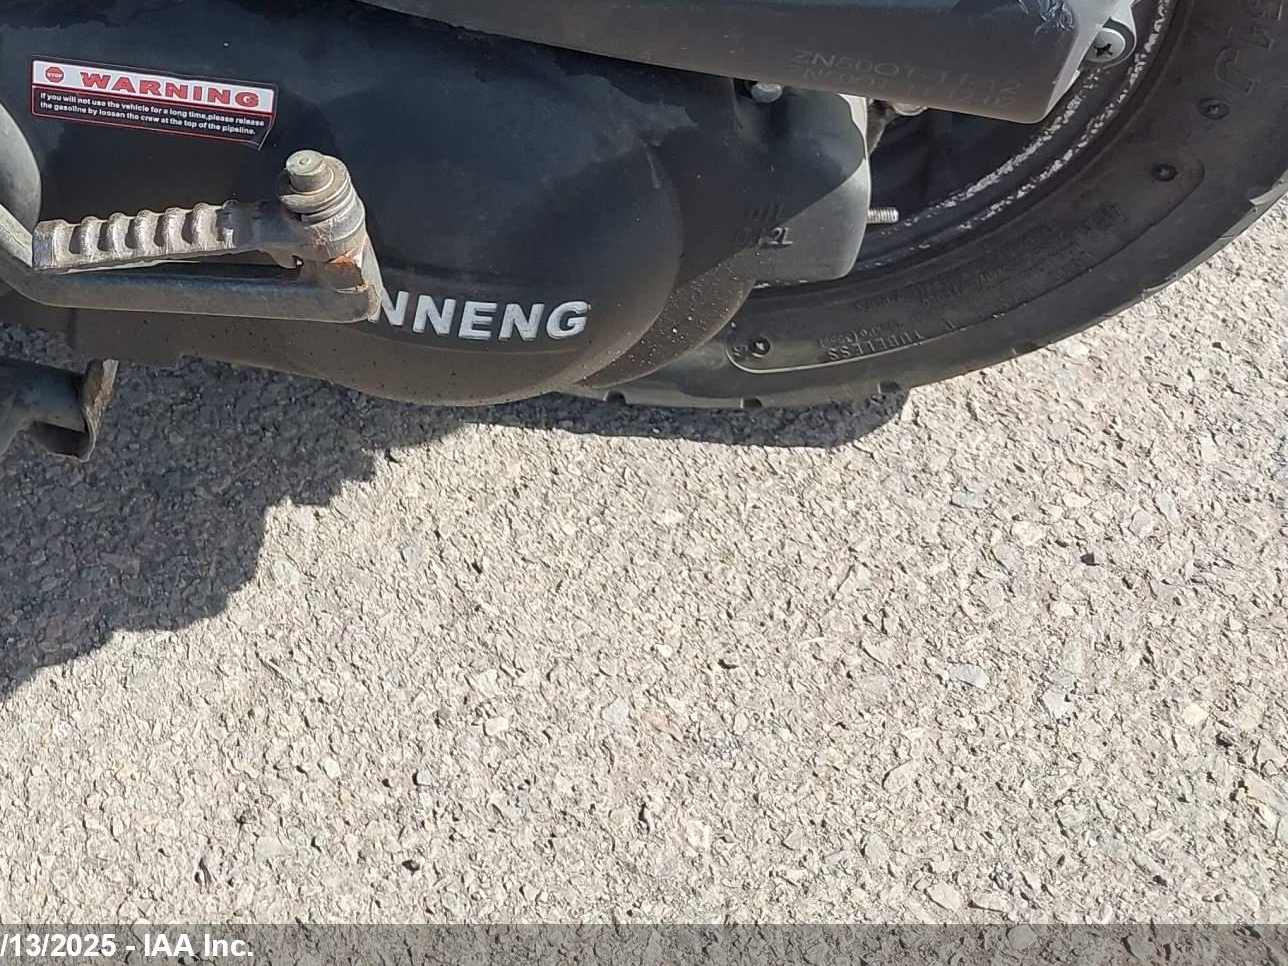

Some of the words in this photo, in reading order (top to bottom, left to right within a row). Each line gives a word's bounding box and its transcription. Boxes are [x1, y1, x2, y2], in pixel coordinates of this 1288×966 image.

[80, 72, 259, 107] WARNING
[40, 92, 46, 100] If
[47, 94, 62, 103] you
[62, 95, 76, 103] will
[108, 100, 120, 109] the
[121, 102, 150, 112] vehicle
[150, 106, 162, 114] for
[170, 108, 188, 118] long
[236, 116, 264, 127] release
[40, 102, 52, 110] the
[54, 104, 86, 114] gasoline
[88, 107, 98, 116] by
[99, 108, 126, 118] loosen
[126, 112, 140, 120] the
[140, 114, 160, 123] crew
[170, 118, 182, 126] the
[184, 120, 198, 128] top
[208, 122, 221, 131] the
[222, 124, 256, 135] pipeline.
